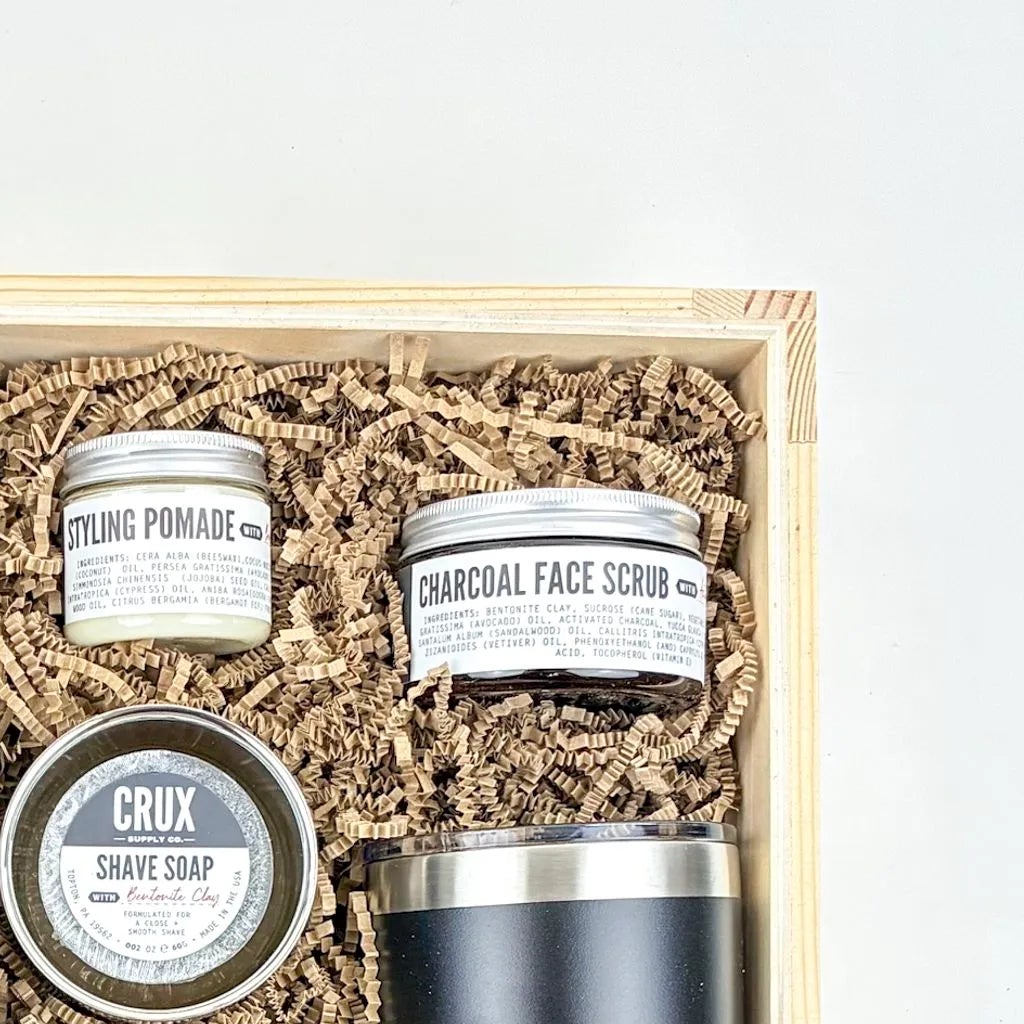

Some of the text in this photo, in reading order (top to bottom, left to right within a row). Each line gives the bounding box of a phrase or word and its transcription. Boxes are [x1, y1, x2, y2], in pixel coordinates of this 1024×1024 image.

[68, 508, 135, 551] STYLING
[144, 506, 235, 541] POMADE
[77, 553, 129, 569] INGREDIENTS:
[136, 552, 160, 561] CERA
[166, 552, 190, 560] ALBA
[151, 563, 187, 571] PERSEA
[117, 574, 169, 584] CHINENSIS
[419, 562, 526, 608] CHARCOAL
[535, 561, 594, 595] FACE
[602, 561, 669, 599] SCRUB
[112, 597, 145, 607] CITRUS
[424, 609, 479, 624] INGREDIENTS:
[486, 604, 540, 616] BENTONITE
[584, 604, 624, 614] SUCROSE
[420, 622, 464, 637] GRATISSIMA
[470, 616, 521, 628] (AVOCADO)
[559, 615, 614, 625] ACTIVATED
[456, 630, 483, 641] ALBUM
[489, 626, 561, 638] (SANDALWOOD)
[483, 638, 536, 649] (VETIVER)
[113, 785, 197, 833] CRUX
[127, 835, 165, 843] SUPPLY
[96, 854, 214, 881] SHAVE SOAP
[90, 886, 220, 908] WITH Bentonite Clay
